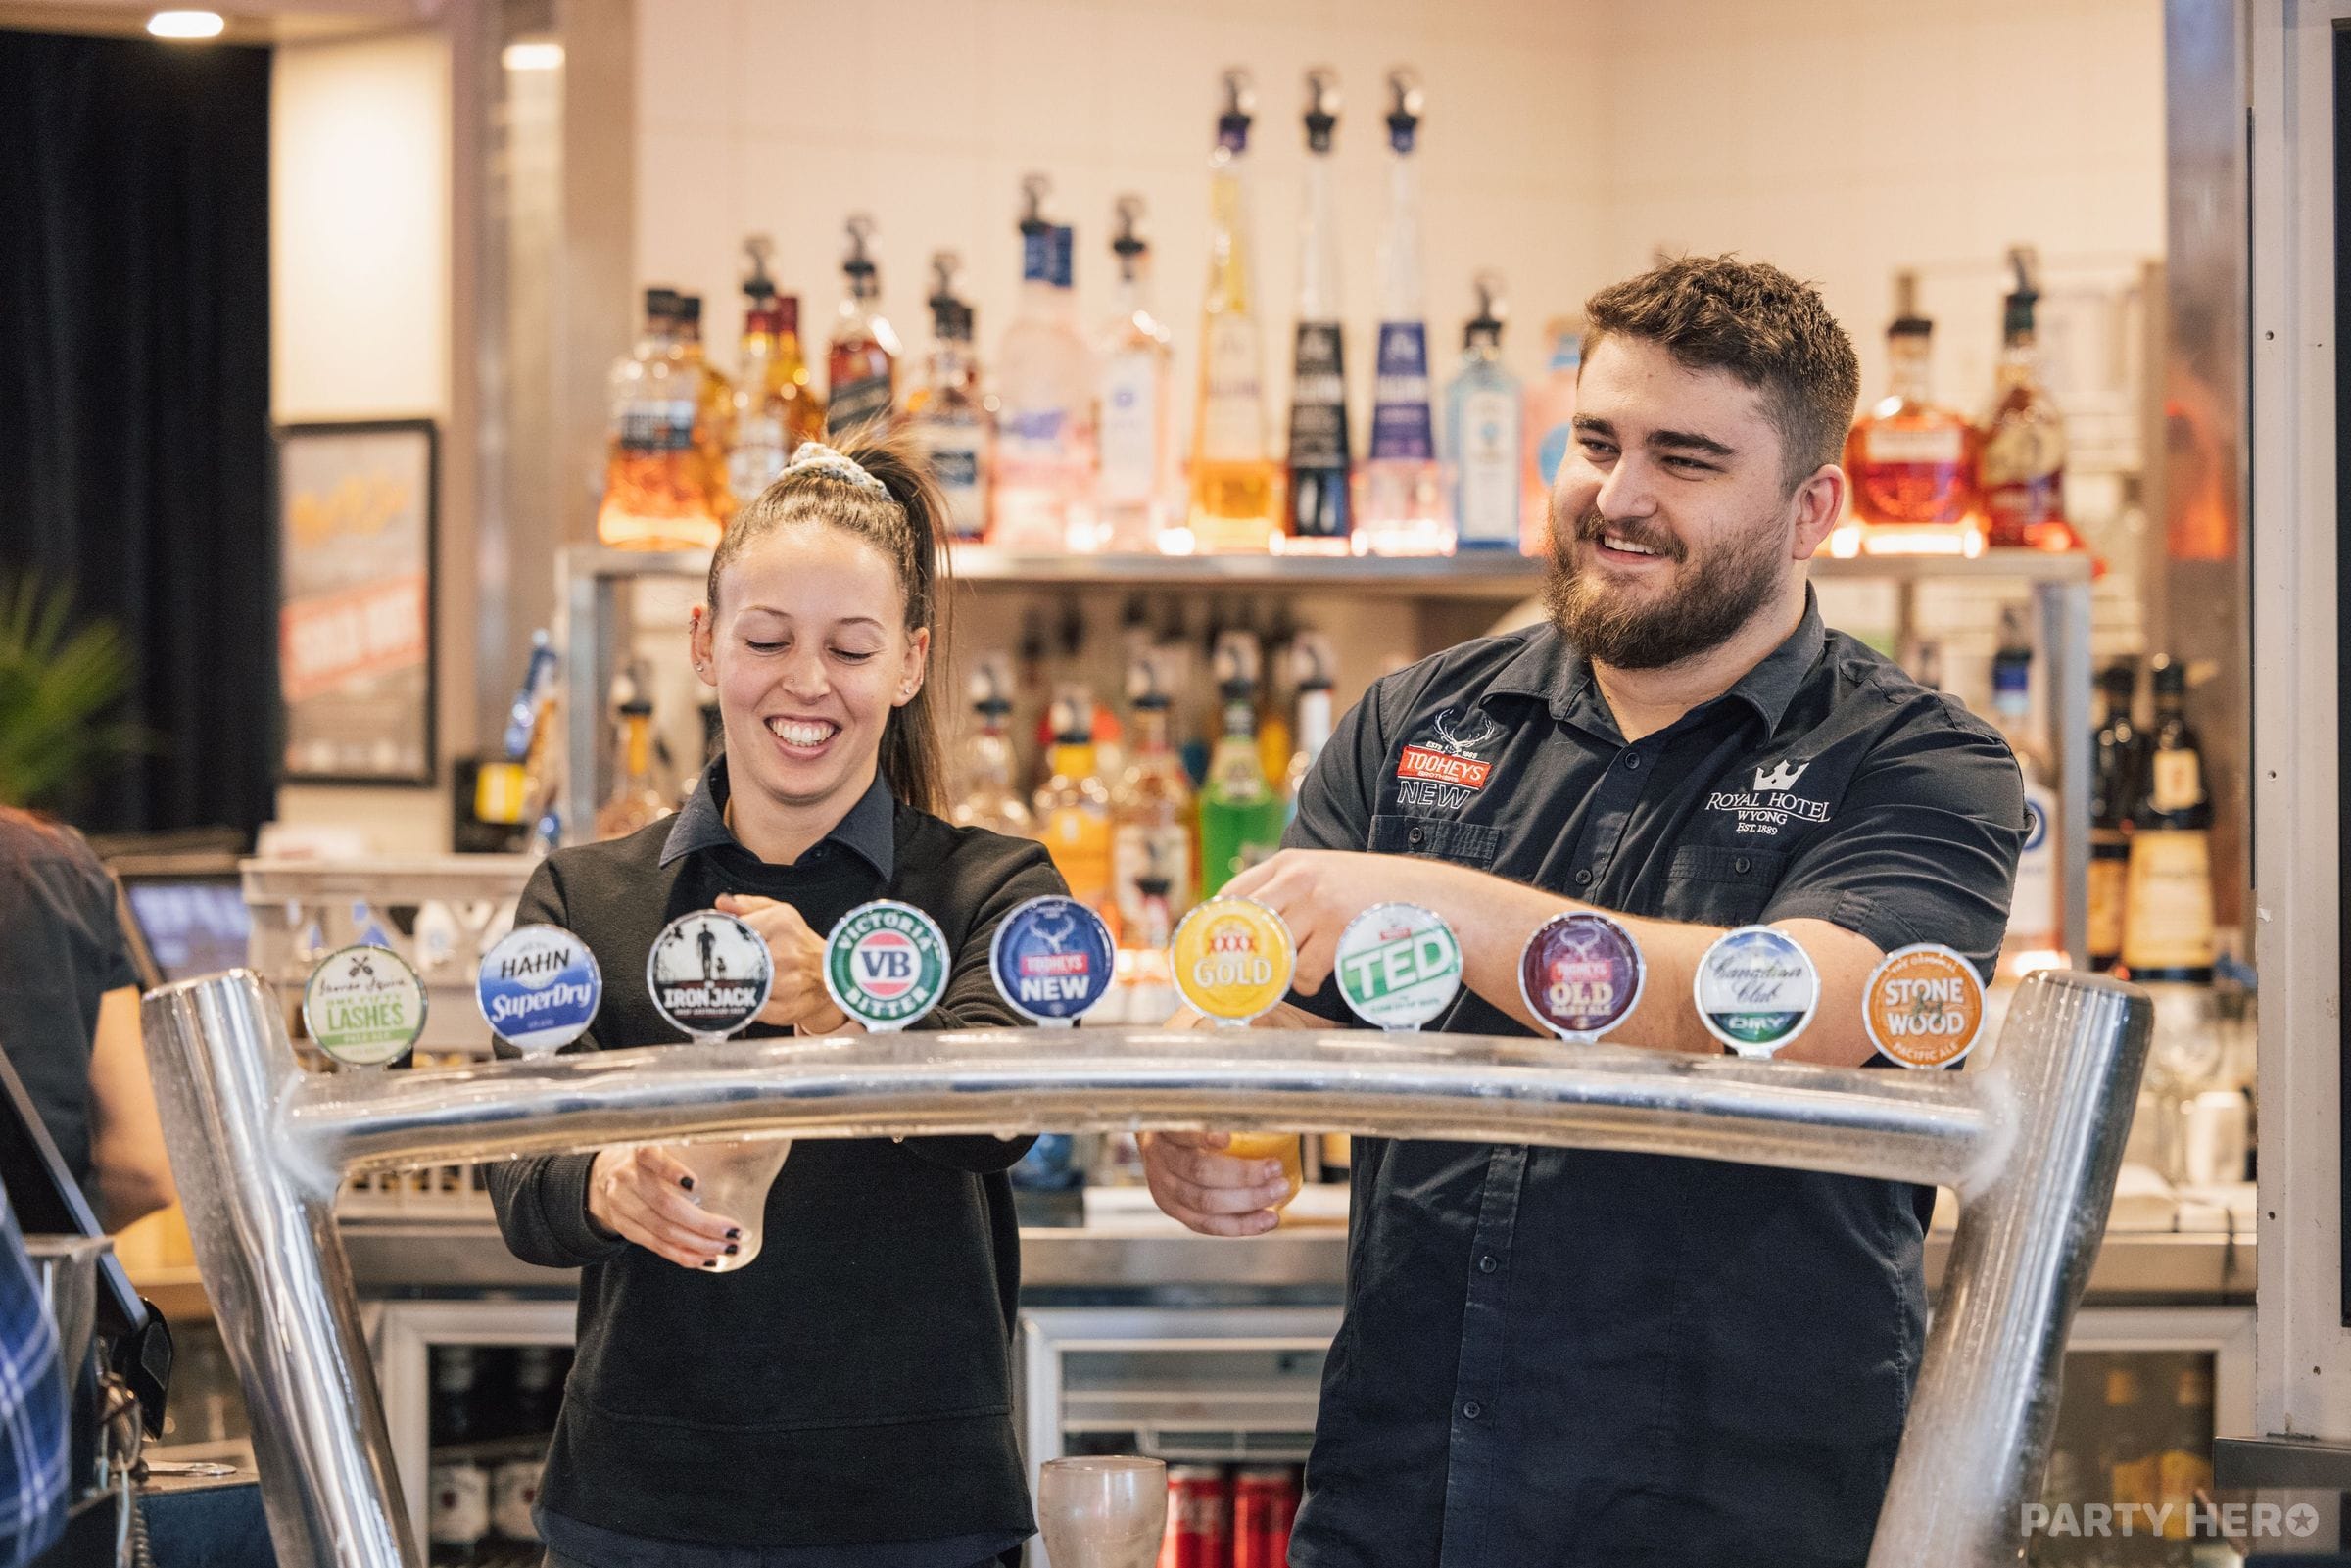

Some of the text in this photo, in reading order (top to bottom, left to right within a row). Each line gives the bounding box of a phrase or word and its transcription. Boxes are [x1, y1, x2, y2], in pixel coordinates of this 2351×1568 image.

[1406, 751, 1485, 782] TOOHEYS
[1397, 780, 1471, 810] NEW
[1704, 792, 1831, 823] ROYAL HOTEL
[1738, 810, 1788, 825] WYONG
[1757, 824, 1779, 836] 1889
[837, 912, 933, 951] VICTORIA
[1206, 934, 1258, 955] XXXX
[500, 948, 570, 980] HAHN
[860, 950, 912, 978] VB
[1192, 956, 1272, 989] GOLD
[1345, 928, 1455, 1000] TED
[490, 981, 593, 1022] SuperDry
[663, 986, 757, 1009] IRON JACK
[844, 986, 930, 1017] BITTER
[1020, 974, 1090, 1003] NEW
[1549, 981, 1614, 1006] OLD
[1884, 976, 1965, 1007] STONE
[327, 1002, 404, 1033] LASHES
[1886, 1011, 1965, 1036] WOOD
